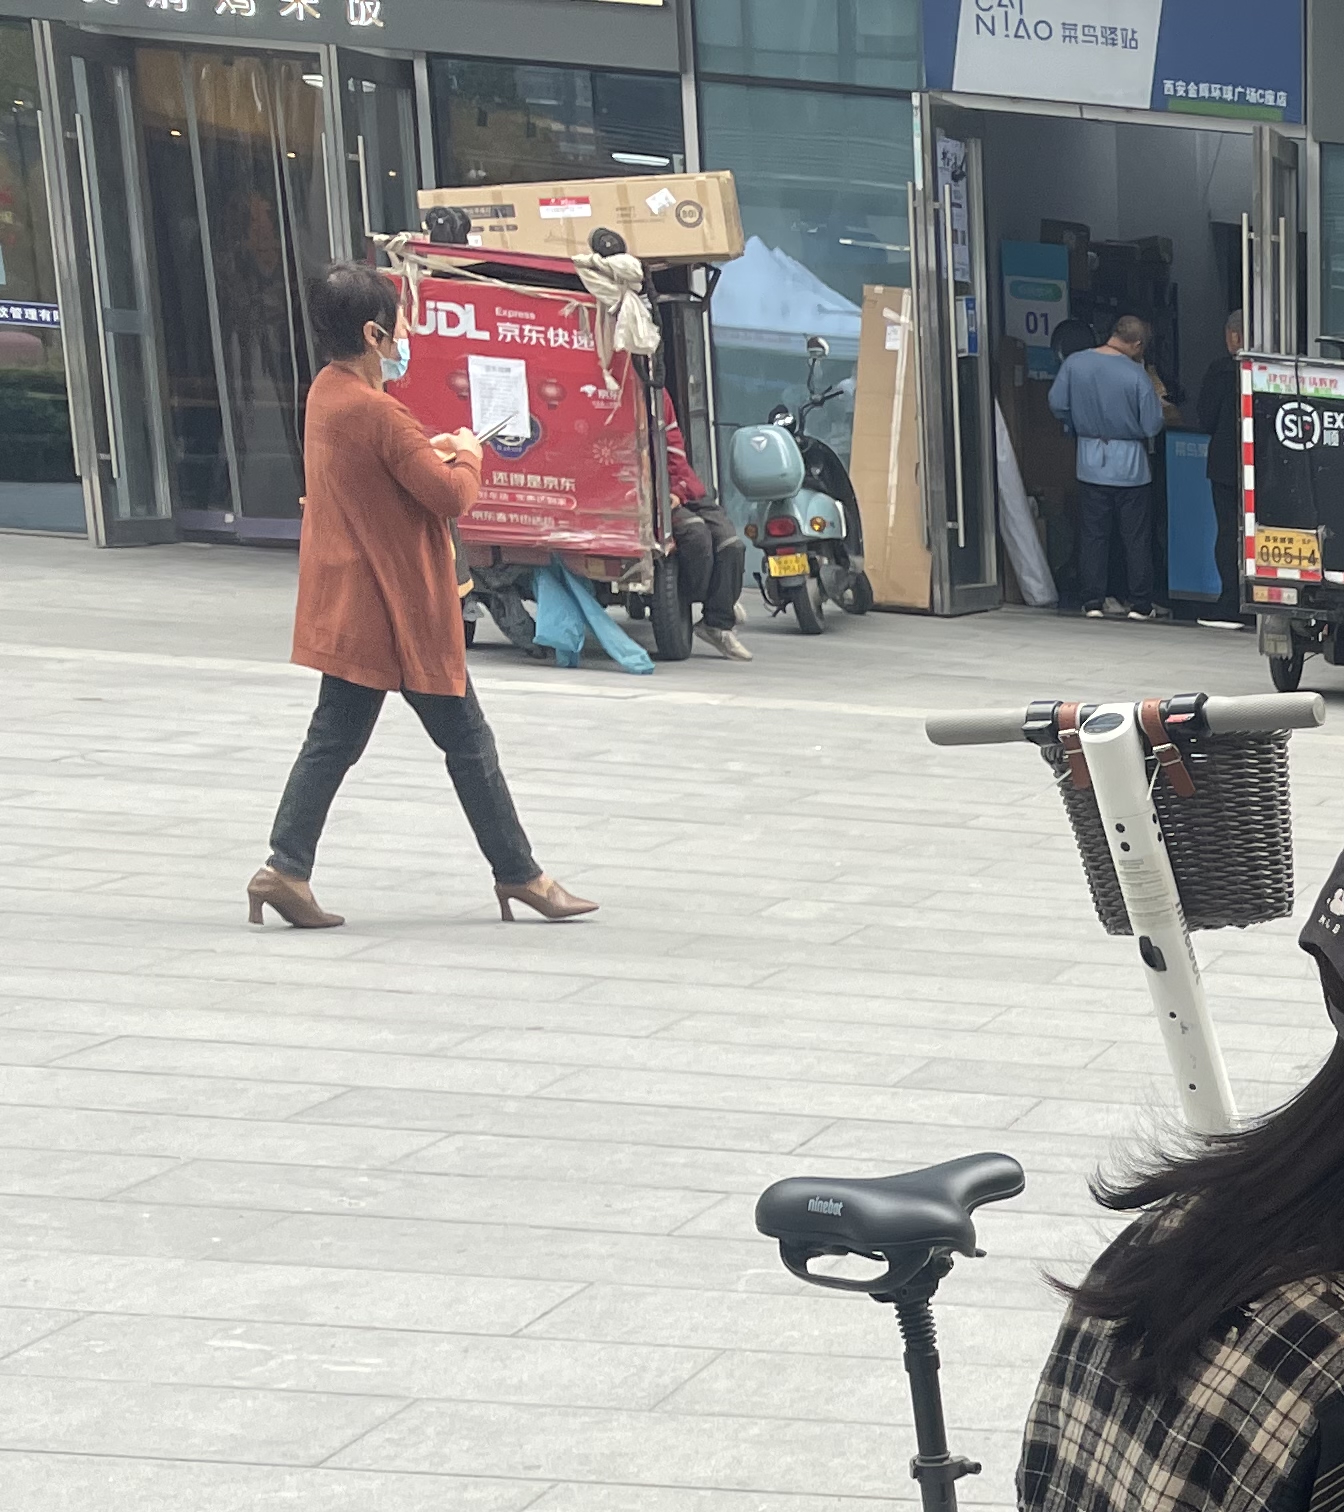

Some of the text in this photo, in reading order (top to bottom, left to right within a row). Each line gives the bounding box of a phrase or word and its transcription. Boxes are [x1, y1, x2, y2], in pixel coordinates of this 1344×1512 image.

[1061, 22, 1138, 50] 菜鸟驿站
[415, 300, 490, 341] JDL
[495, 307, 536, 320] Express
[1025, 311, 1050, 336] 01
[497, 322, 596, 351] 京东快递
[808, 1195, 843, 1216] ninebot
